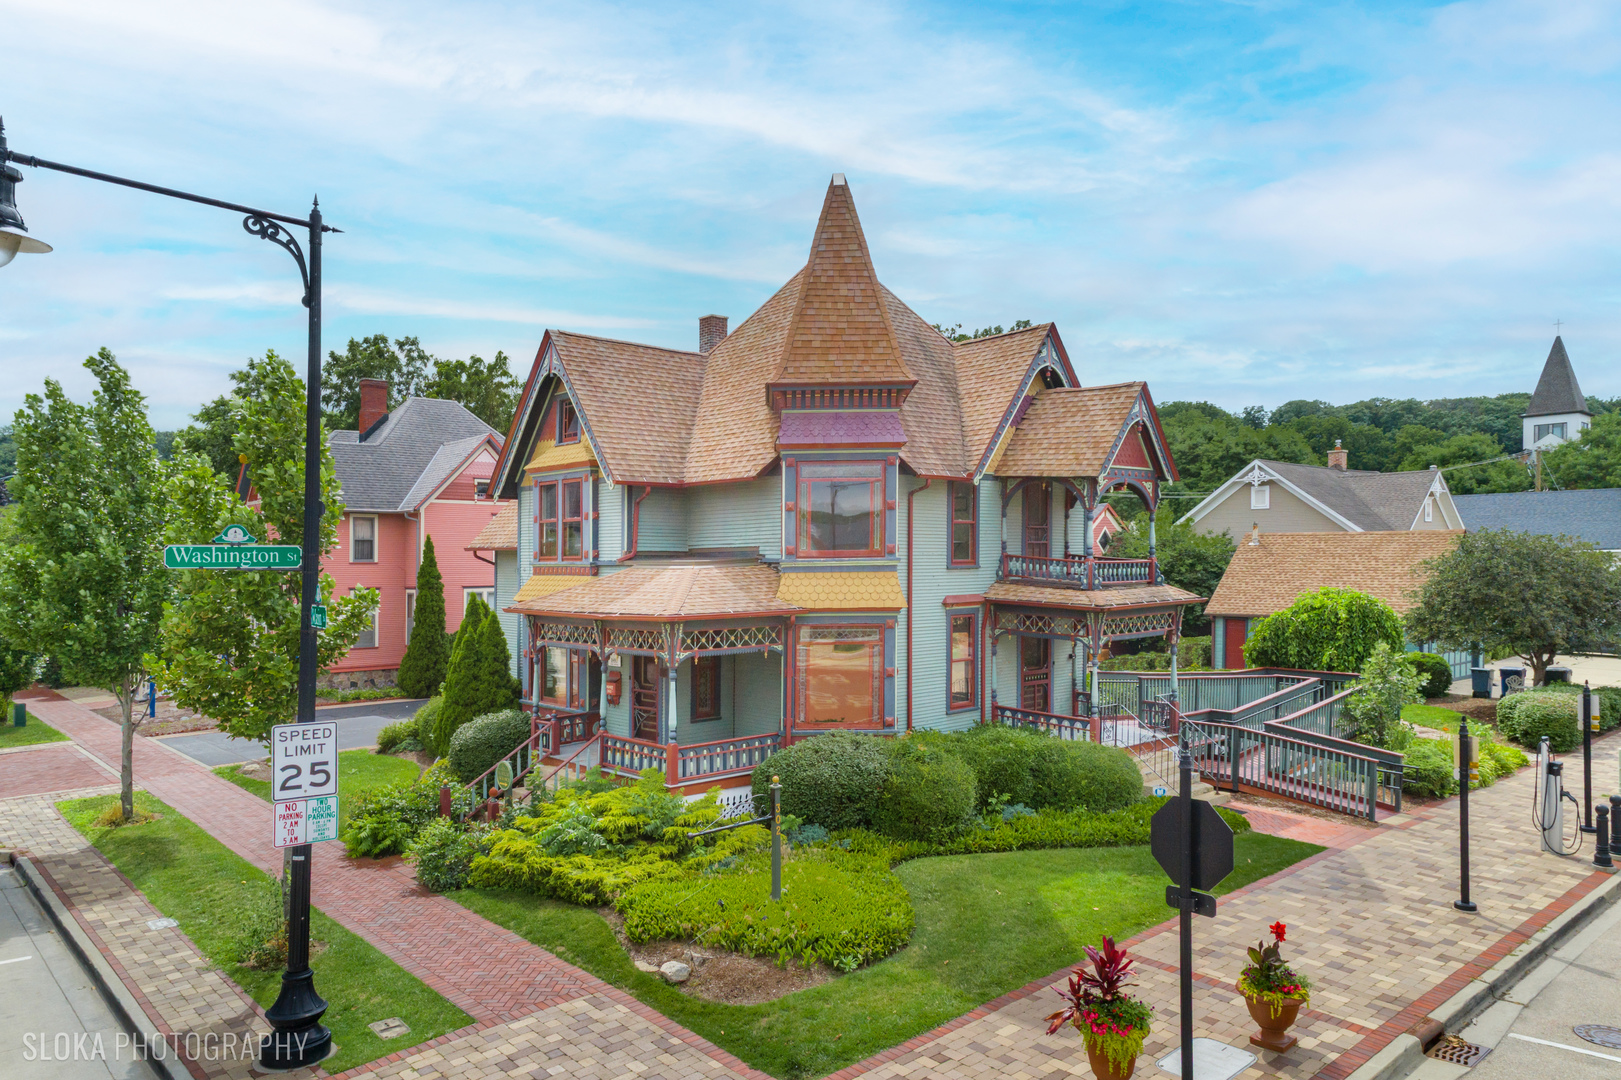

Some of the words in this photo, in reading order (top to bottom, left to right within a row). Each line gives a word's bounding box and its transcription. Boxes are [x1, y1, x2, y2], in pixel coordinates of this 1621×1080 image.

[172, 547, 279, 568] Washington
[287, 552, 297, 561] St
[279, 728, 332, 742] SPEED
[285, 743, 326, 757] LIMIT
[279, 761, 331, 791] 25
[285, 802, 298, 812] NO
[316, 798, 328, 806] TWO
[312, 804, 332, 814] HOUR
[278, 811, 303, 821] PARKING
[308, 811, 336, 821] PARKING
[290, 820, 298, 828] AM
[283, 837, 287, 845] 5
[289, 836, 298, 844] AM
